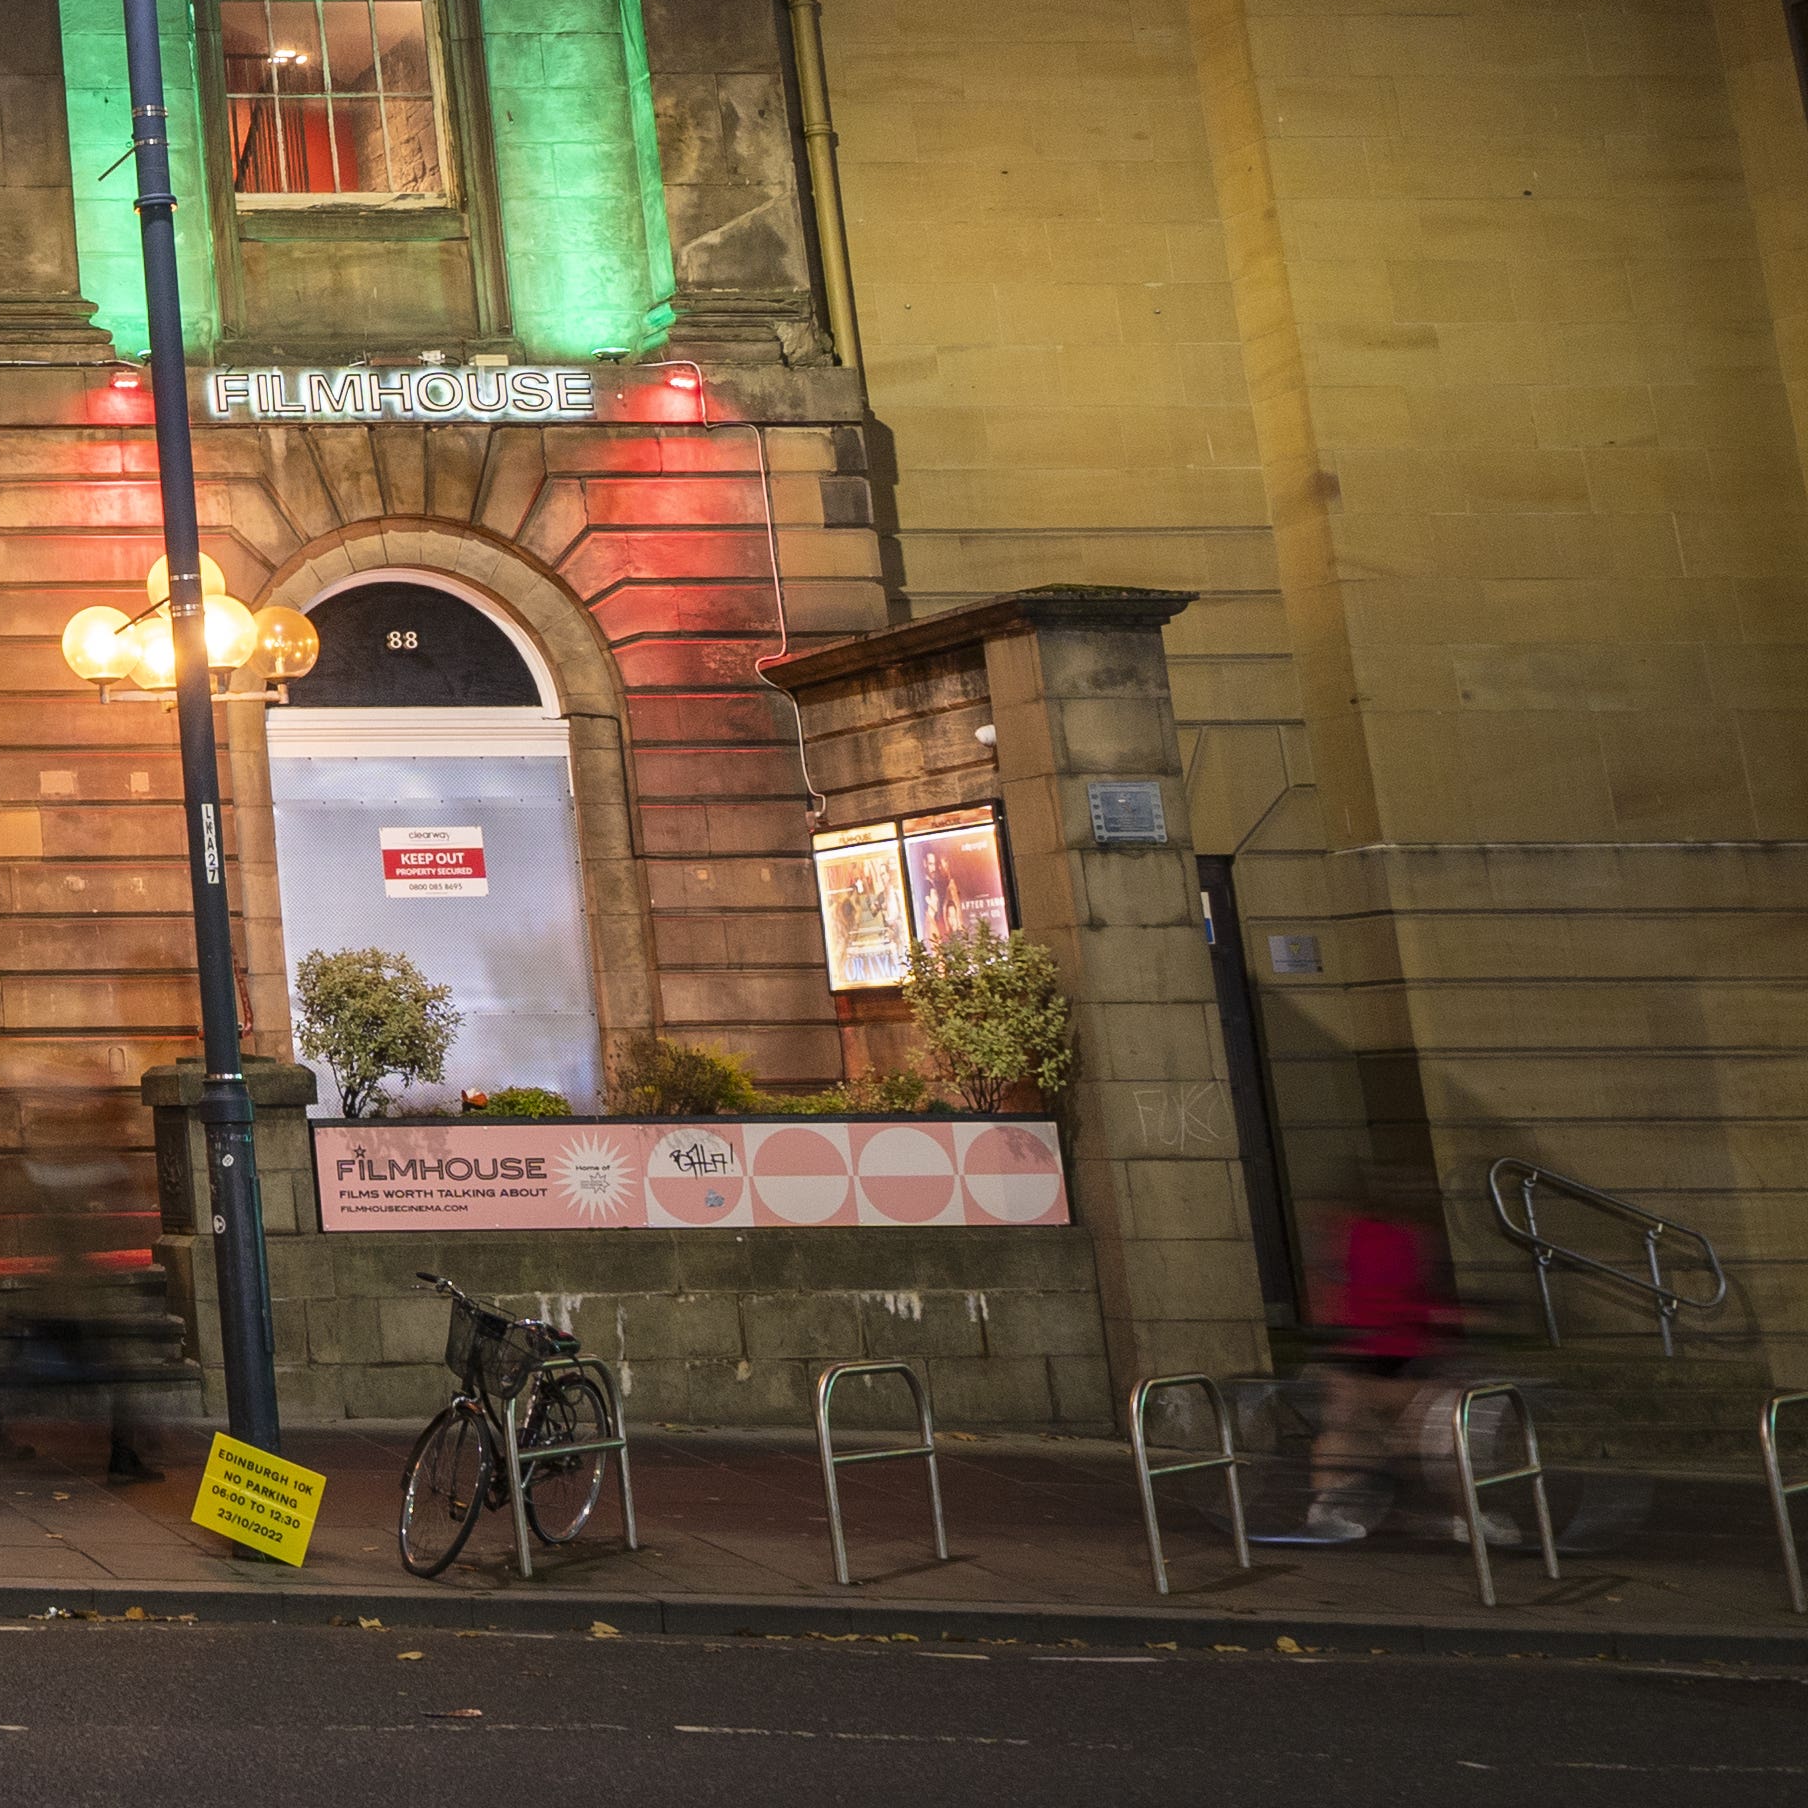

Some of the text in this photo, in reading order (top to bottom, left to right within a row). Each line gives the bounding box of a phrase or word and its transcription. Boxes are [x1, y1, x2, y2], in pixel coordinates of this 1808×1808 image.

[214, 371, 596, 414] FILMHOUSE
[386, 630, 419, 650] 88
[408, 831, 450, 841] clearway
[395, 867, 473, 876] PROPERTY SECURED
[400, 852, 465, 865] KEEP OUT
[336, 1144, 547, 1181] FILMHOUSE
[340, 1188, 548, 1199] FILMS WORTH TALKING ABOUT
[340, 1204, 468, 1213] FILMHOUSECINEMA.COM
[218, 1448, 314, 1496] EDINBURGH 10K
[224, 1470, 298, 1509] NO PARKING
[212, 1484, 301, 1530] 06:00 TO 12:30
[217, 1507, 285, 1543] 23/10/2022
